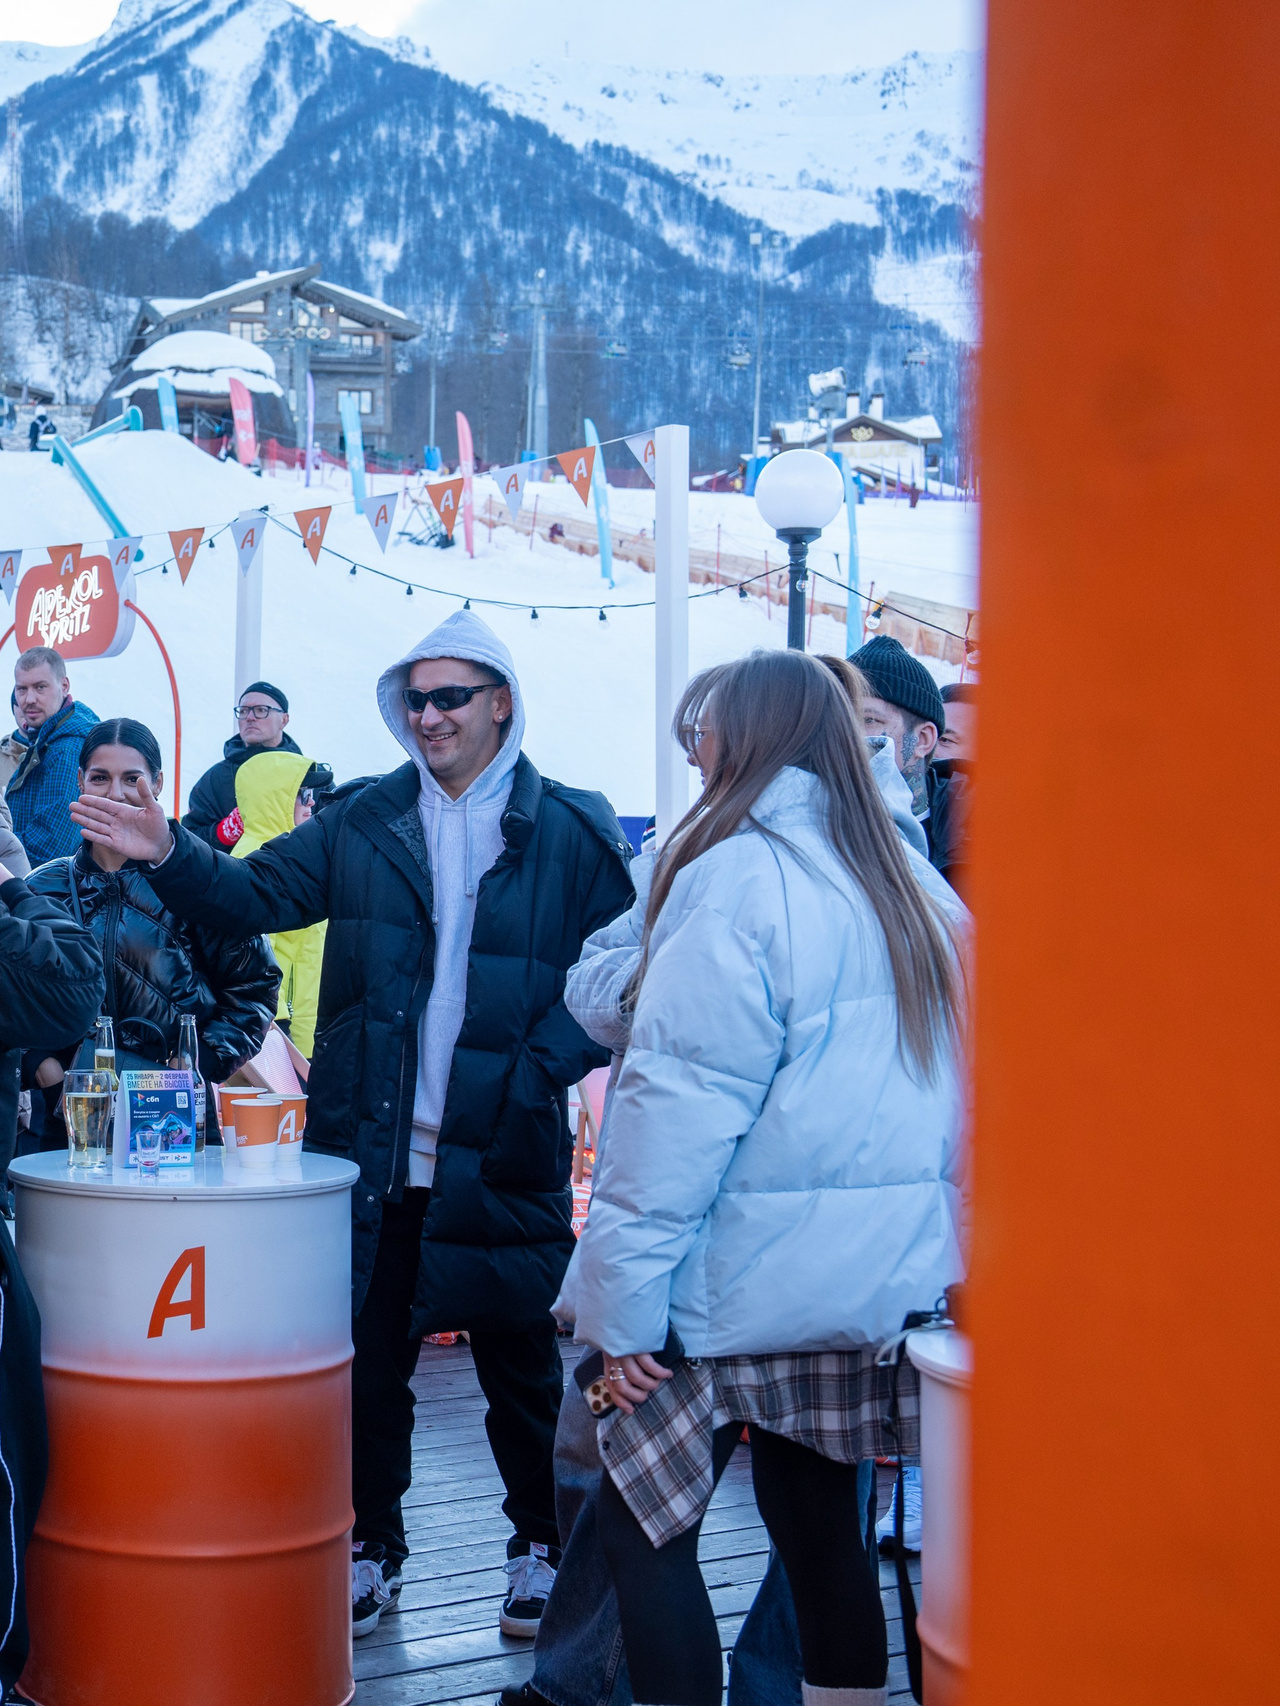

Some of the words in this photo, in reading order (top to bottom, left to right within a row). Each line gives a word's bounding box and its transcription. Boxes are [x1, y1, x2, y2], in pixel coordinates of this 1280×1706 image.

[127, 1081, 153, 1089] ВМЕСТЕ
[164, 1080, 190, 1088] ВЫСОТЕ
[147, 1245, 206, 1339] A
